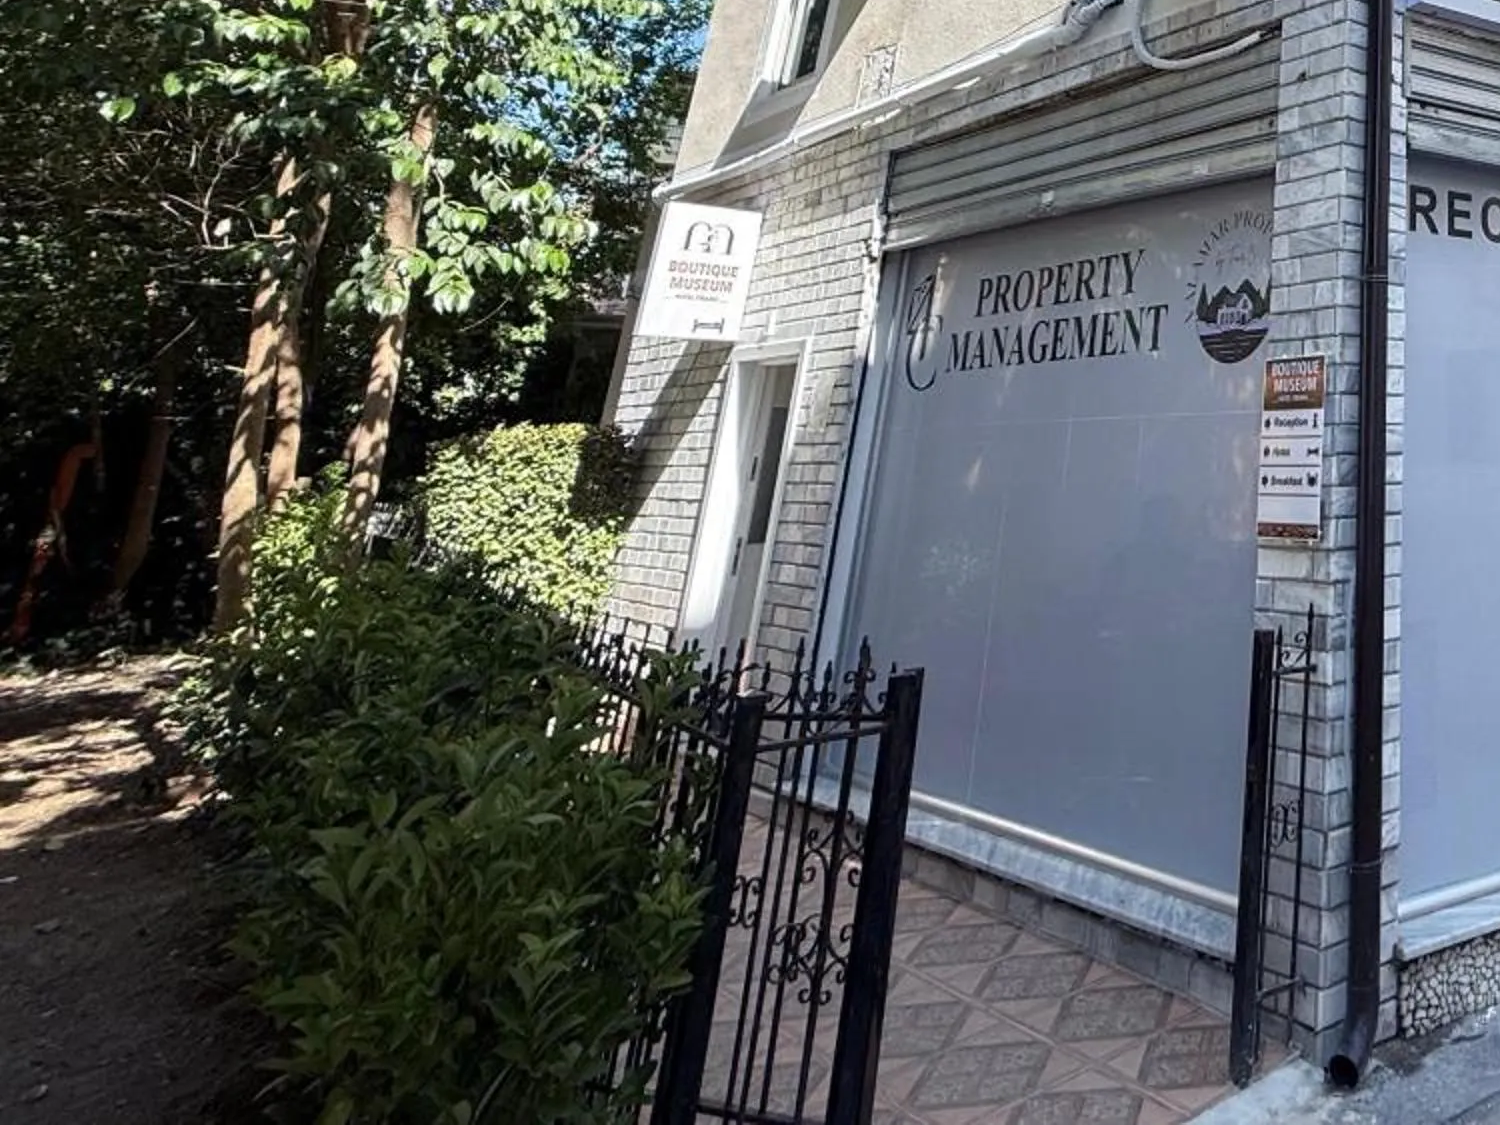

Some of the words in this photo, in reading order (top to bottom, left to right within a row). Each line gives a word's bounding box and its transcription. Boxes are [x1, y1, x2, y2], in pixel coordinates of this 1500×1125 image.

[668, 260, 739, 277] BOUTIQUE
[669, 276, 732, 293] MUSEUM
[974, 248, 1146, 318] PROPERTY
[946, 304, 1169, 373] MANAGEMENT
[1271, 360, 1320, 376] BOUTIQUE
[1273, 377, 1317, 393] MUSEUM
[1273, 416, 1309, 429] Reception
